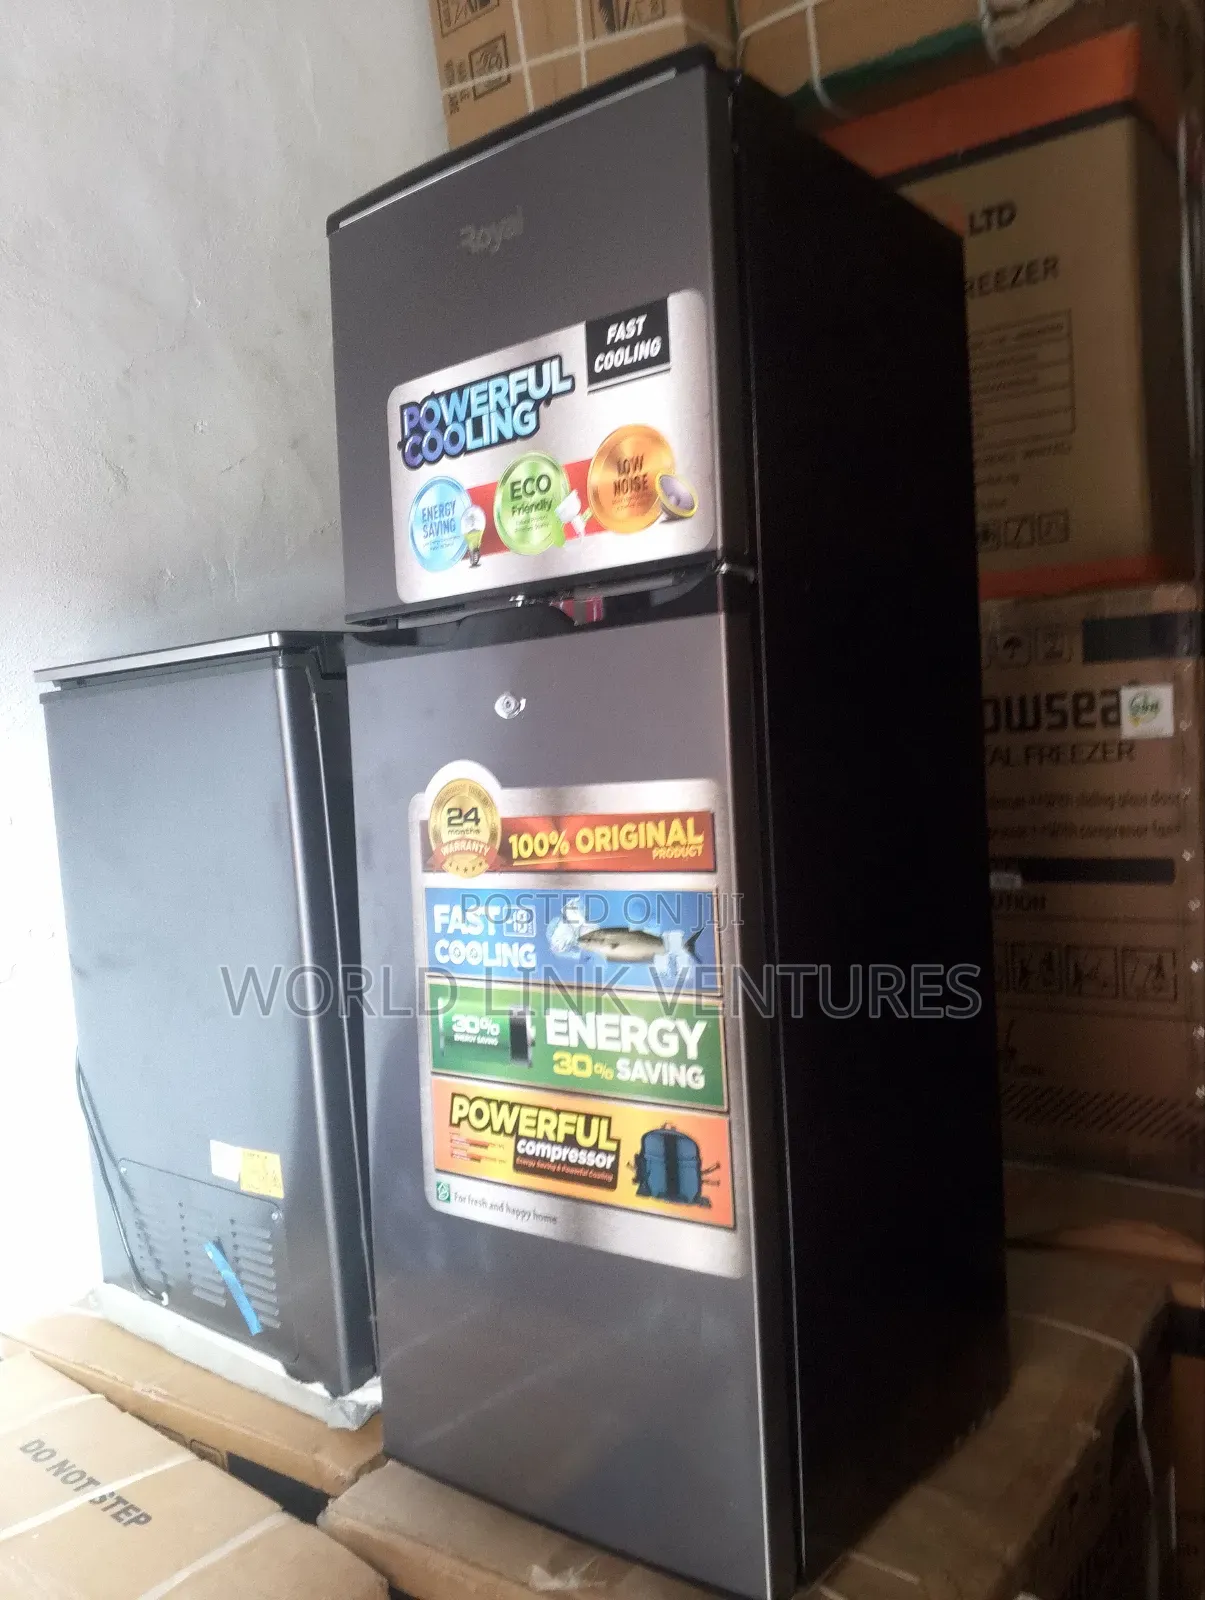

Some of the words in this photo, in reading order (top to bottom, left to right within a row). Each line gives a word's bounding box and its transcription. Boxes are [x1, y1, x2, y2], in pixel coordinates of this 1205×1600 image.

[968, 200, 1017, 238] LTD
[606, 313, 647, 345] FAST
[594, 336, 662, 373] COOLING
[402, 356, 574, 438] POWERFUL
[400, 401, 540, 470] COOLING
[616, 453, 644, 476] LOW
[510, 474, 552, 502] ECO
[613, 472, 648, 497] NOISE
[421, 499, 457, 523] ENERGY
[423, 518, 456, 540] SAVING
[446, 806, 481, 829] 24
[447, 828, 480, 836] months
[440, 839, 491, 858] WARRANTY
[509, 830, 570, 858] 100%
[575, 816, 704, 854] ORIGINAL
[651, 844, 704, 860] PRODUCT
[433, 904, 501, 935] FAST
[434, 939, 537, 968] COOLING
[452, 1014, 501, 1036] 30%
[545, 1008, 707, 1060] ENERGY
[553, 1051, 613, 1081] 30%
[616, 1058, 706, 1089] SAVING
[451, 1094, 620, 1152] POWERFUL
[516, 1138, 616, 1170] compressor
[467, 1195, 487, 1209] fresh
[488, 1203, 504, 1213] and
[505, 1203, 532, 1221] happy
[532, 1207, 557, 1225] home
[19, 1438, 57, 1463] DO
[45, 1458, 101, 1492] NOT
[88, 1490, 152, 1526] STEP
